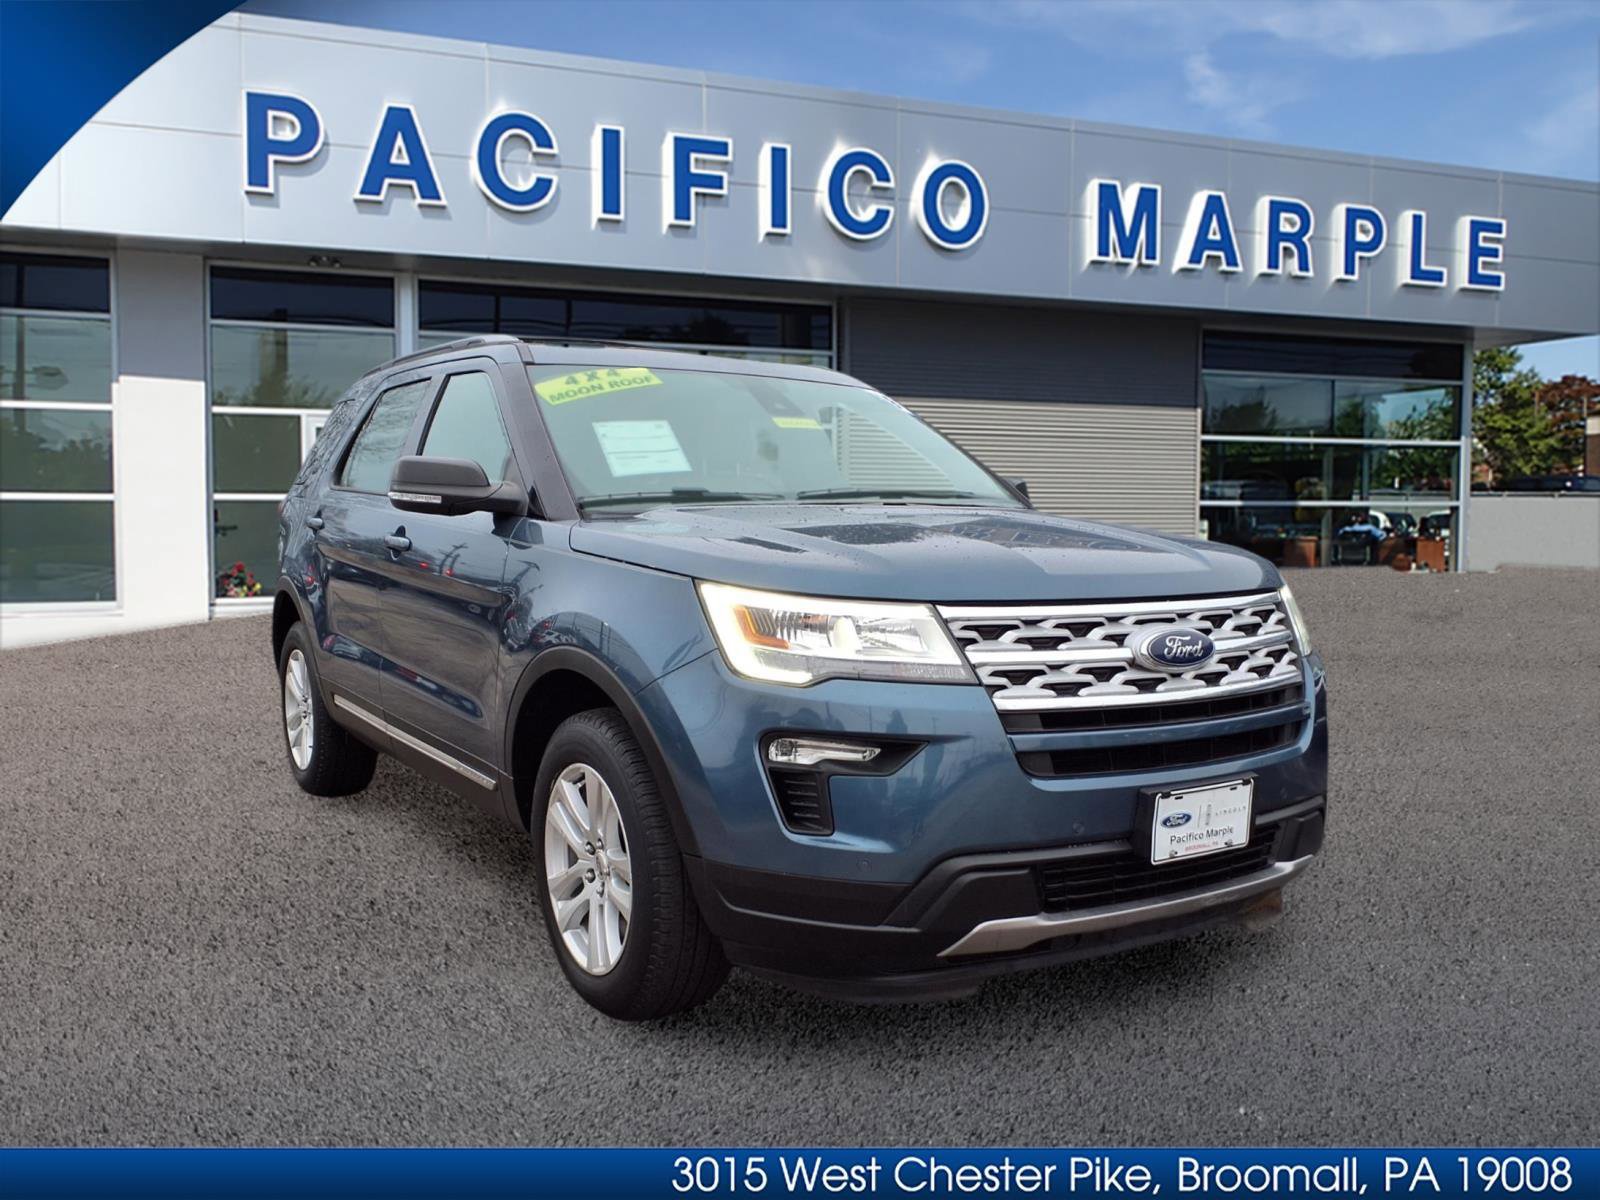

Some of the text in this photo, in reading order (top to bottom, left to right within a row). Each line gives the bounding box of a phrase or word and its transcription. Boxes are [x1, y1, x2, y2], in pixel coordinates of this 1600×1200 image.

[242, 88, 1507, 291] PACIFICO MARPLE
[549, 374, 654, 403] MOON ROOF
[1164, 635, 1204, 659] Ford
[1170, 826, 1234, 845] Pacifico Marple
